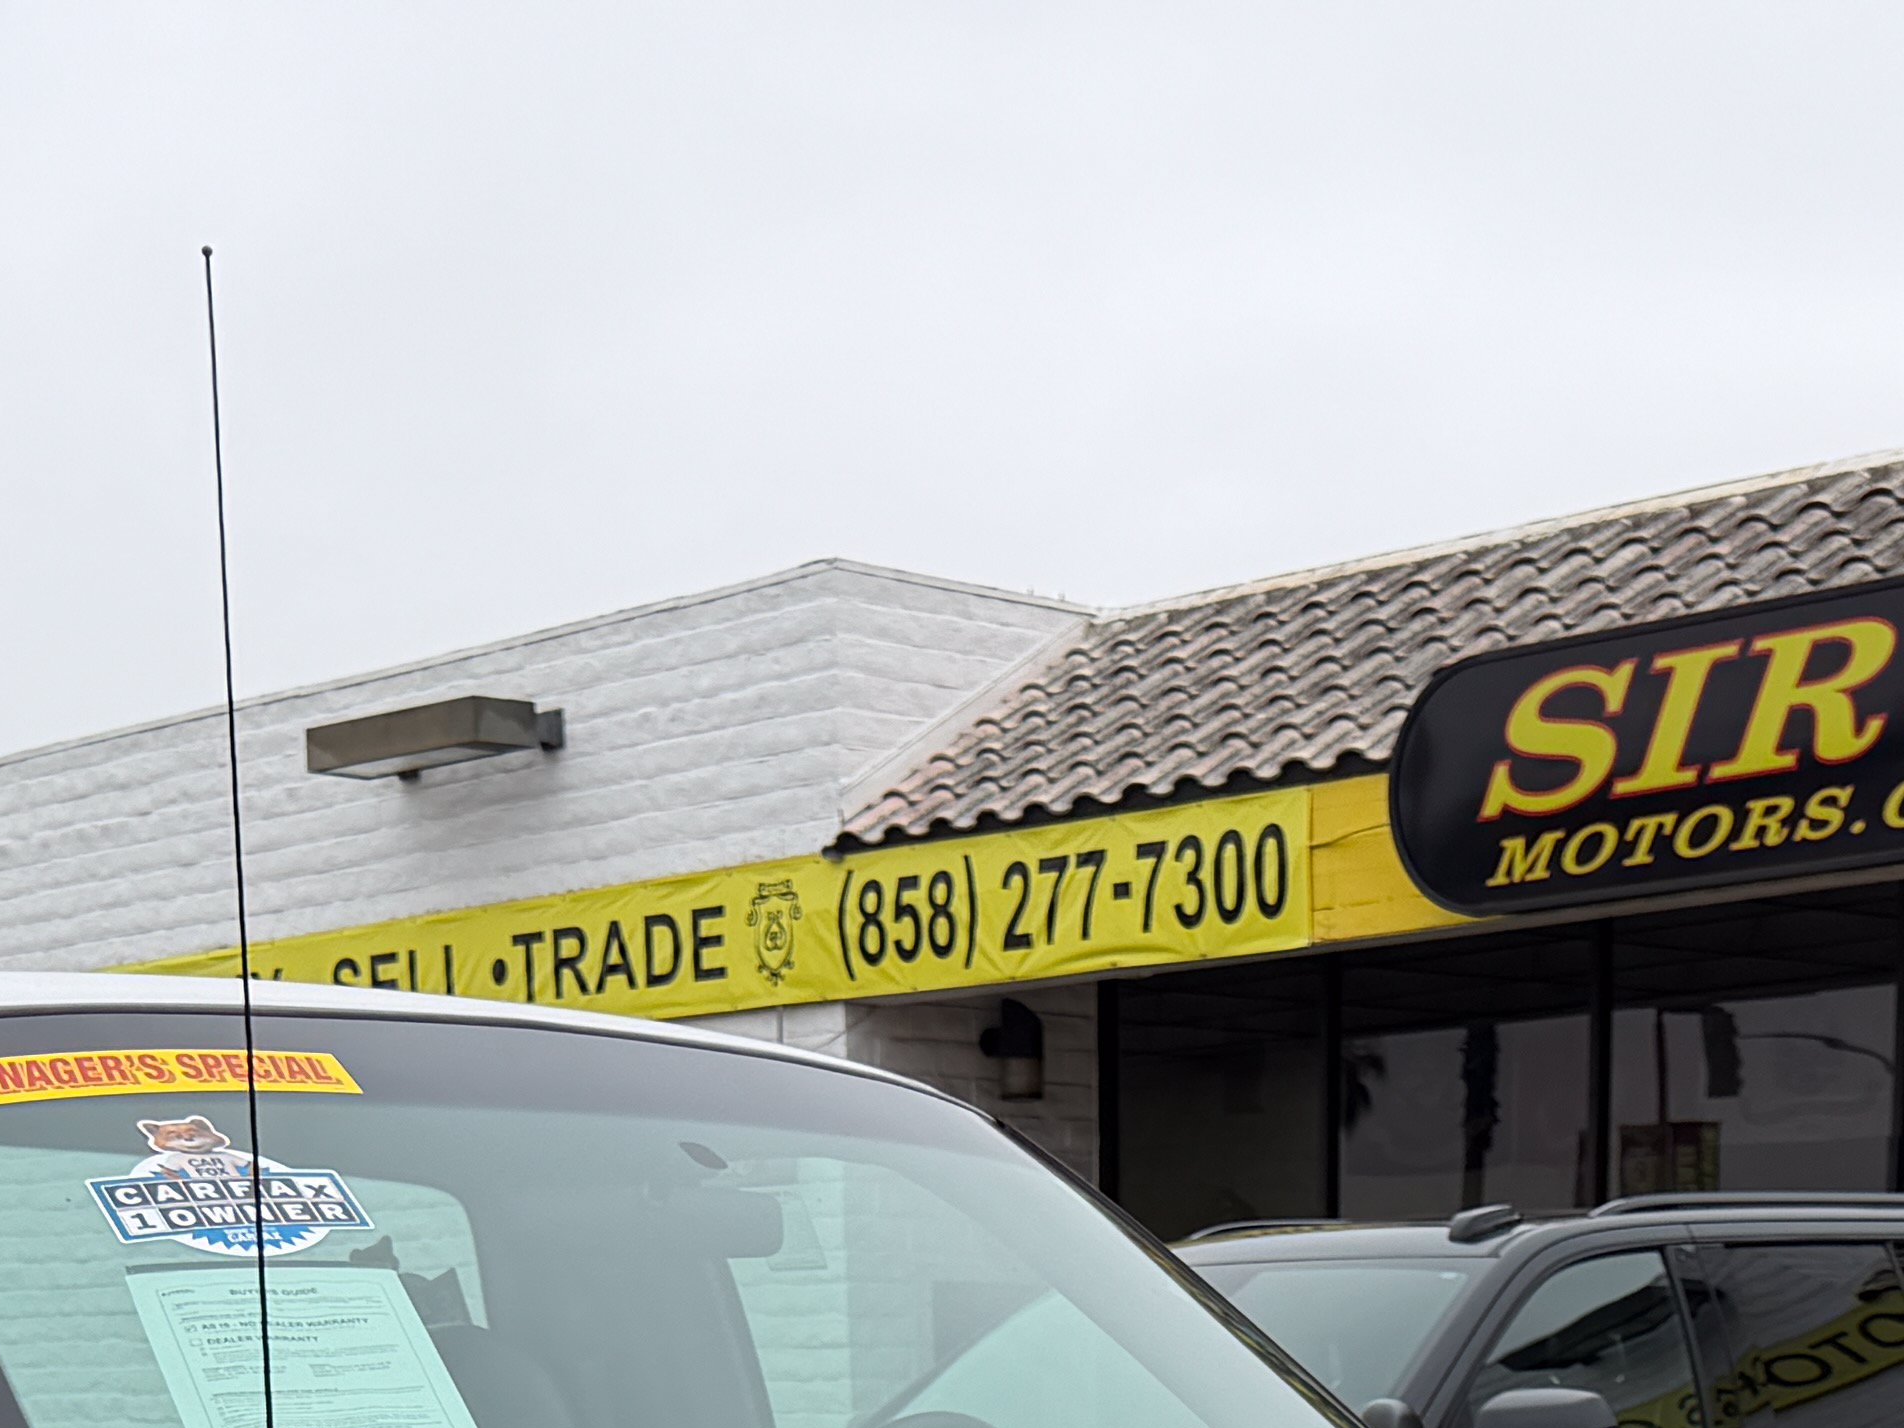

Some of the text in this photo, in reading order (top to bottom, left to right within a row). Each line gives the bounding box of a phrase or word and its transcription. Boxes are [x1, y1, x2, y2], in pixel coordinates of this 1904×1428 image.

[838, 854, 979, 982] (858)
[1001, 823, 1288, 952] 277-7300
[174, 1053, 341, 1084] SPECIAL
[187, 1157, 225, 1169] CAR
[196, 1166, 230, 1177] FOX
[112, 1180, 339, 1206] CARFAX
[129, 1203, 350, 1232] 1 OWNER
